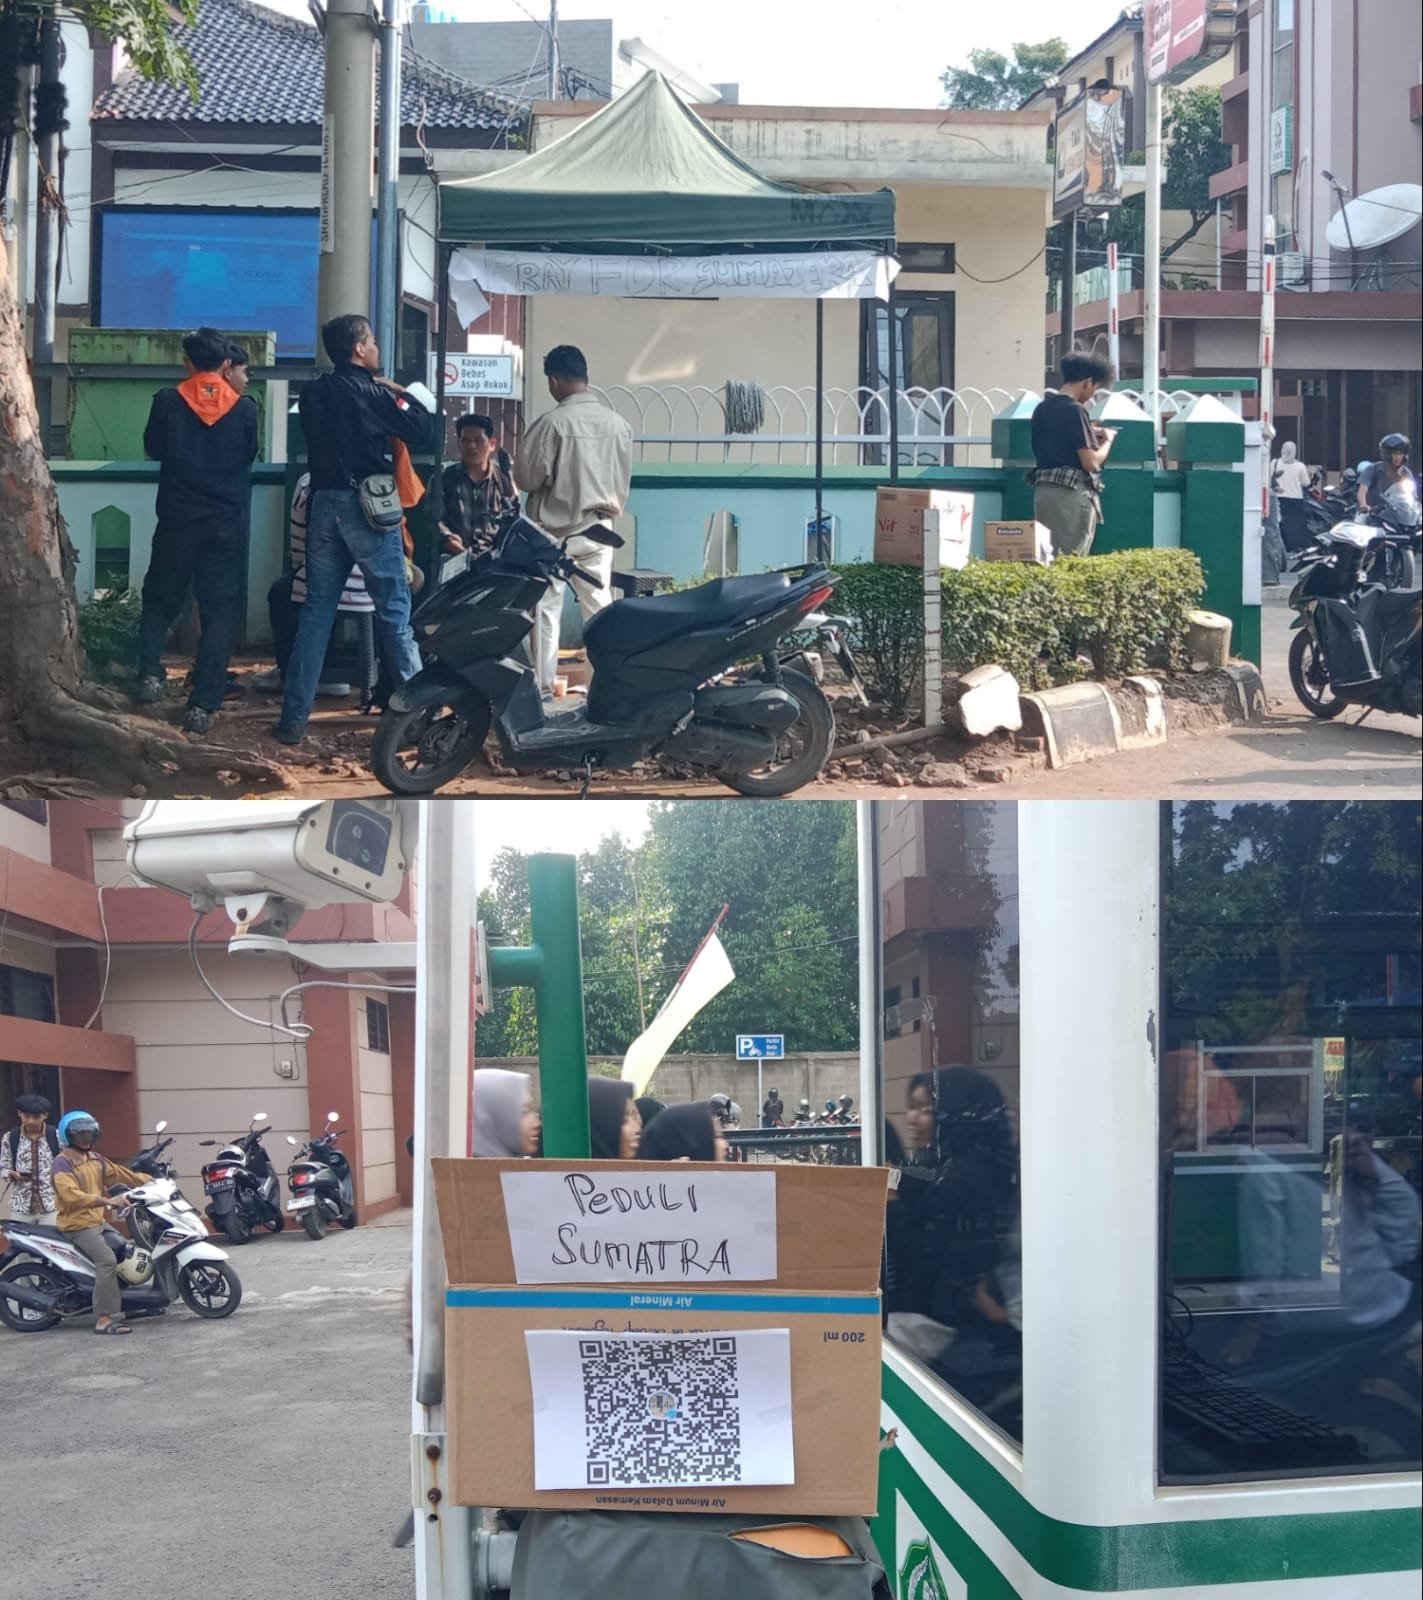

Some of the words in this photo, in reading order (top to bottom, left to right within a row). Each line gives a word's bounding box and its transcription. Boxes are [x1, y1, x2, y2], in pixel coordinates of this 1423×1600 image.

[484, 252, 580, 294] PRAY
[590, 257, 682, 297] FOR
[461, 358, 498, 367] Kawasan
[461, 368, 487, 378] Bebas
[461, 380, 480, 390] Asap
[484, 380, 508, 389] Rokok
[878, 517, 898, 534] Vit
[740, 1038, 754, 1054] P
[630, 1295, 673, 1307] Mineral
[675, 1296, 693, 1307] Air
[823, 1332, 840, 1343] ml
[841, 1332, 865, 1343] 200
[595, 1496, 641, 1505] Kemasan
[642, 1497, 674, 1506] Dalam
[675, 1497, 710, 1507] Minum
[711, 1498, 727, 1507] Air
